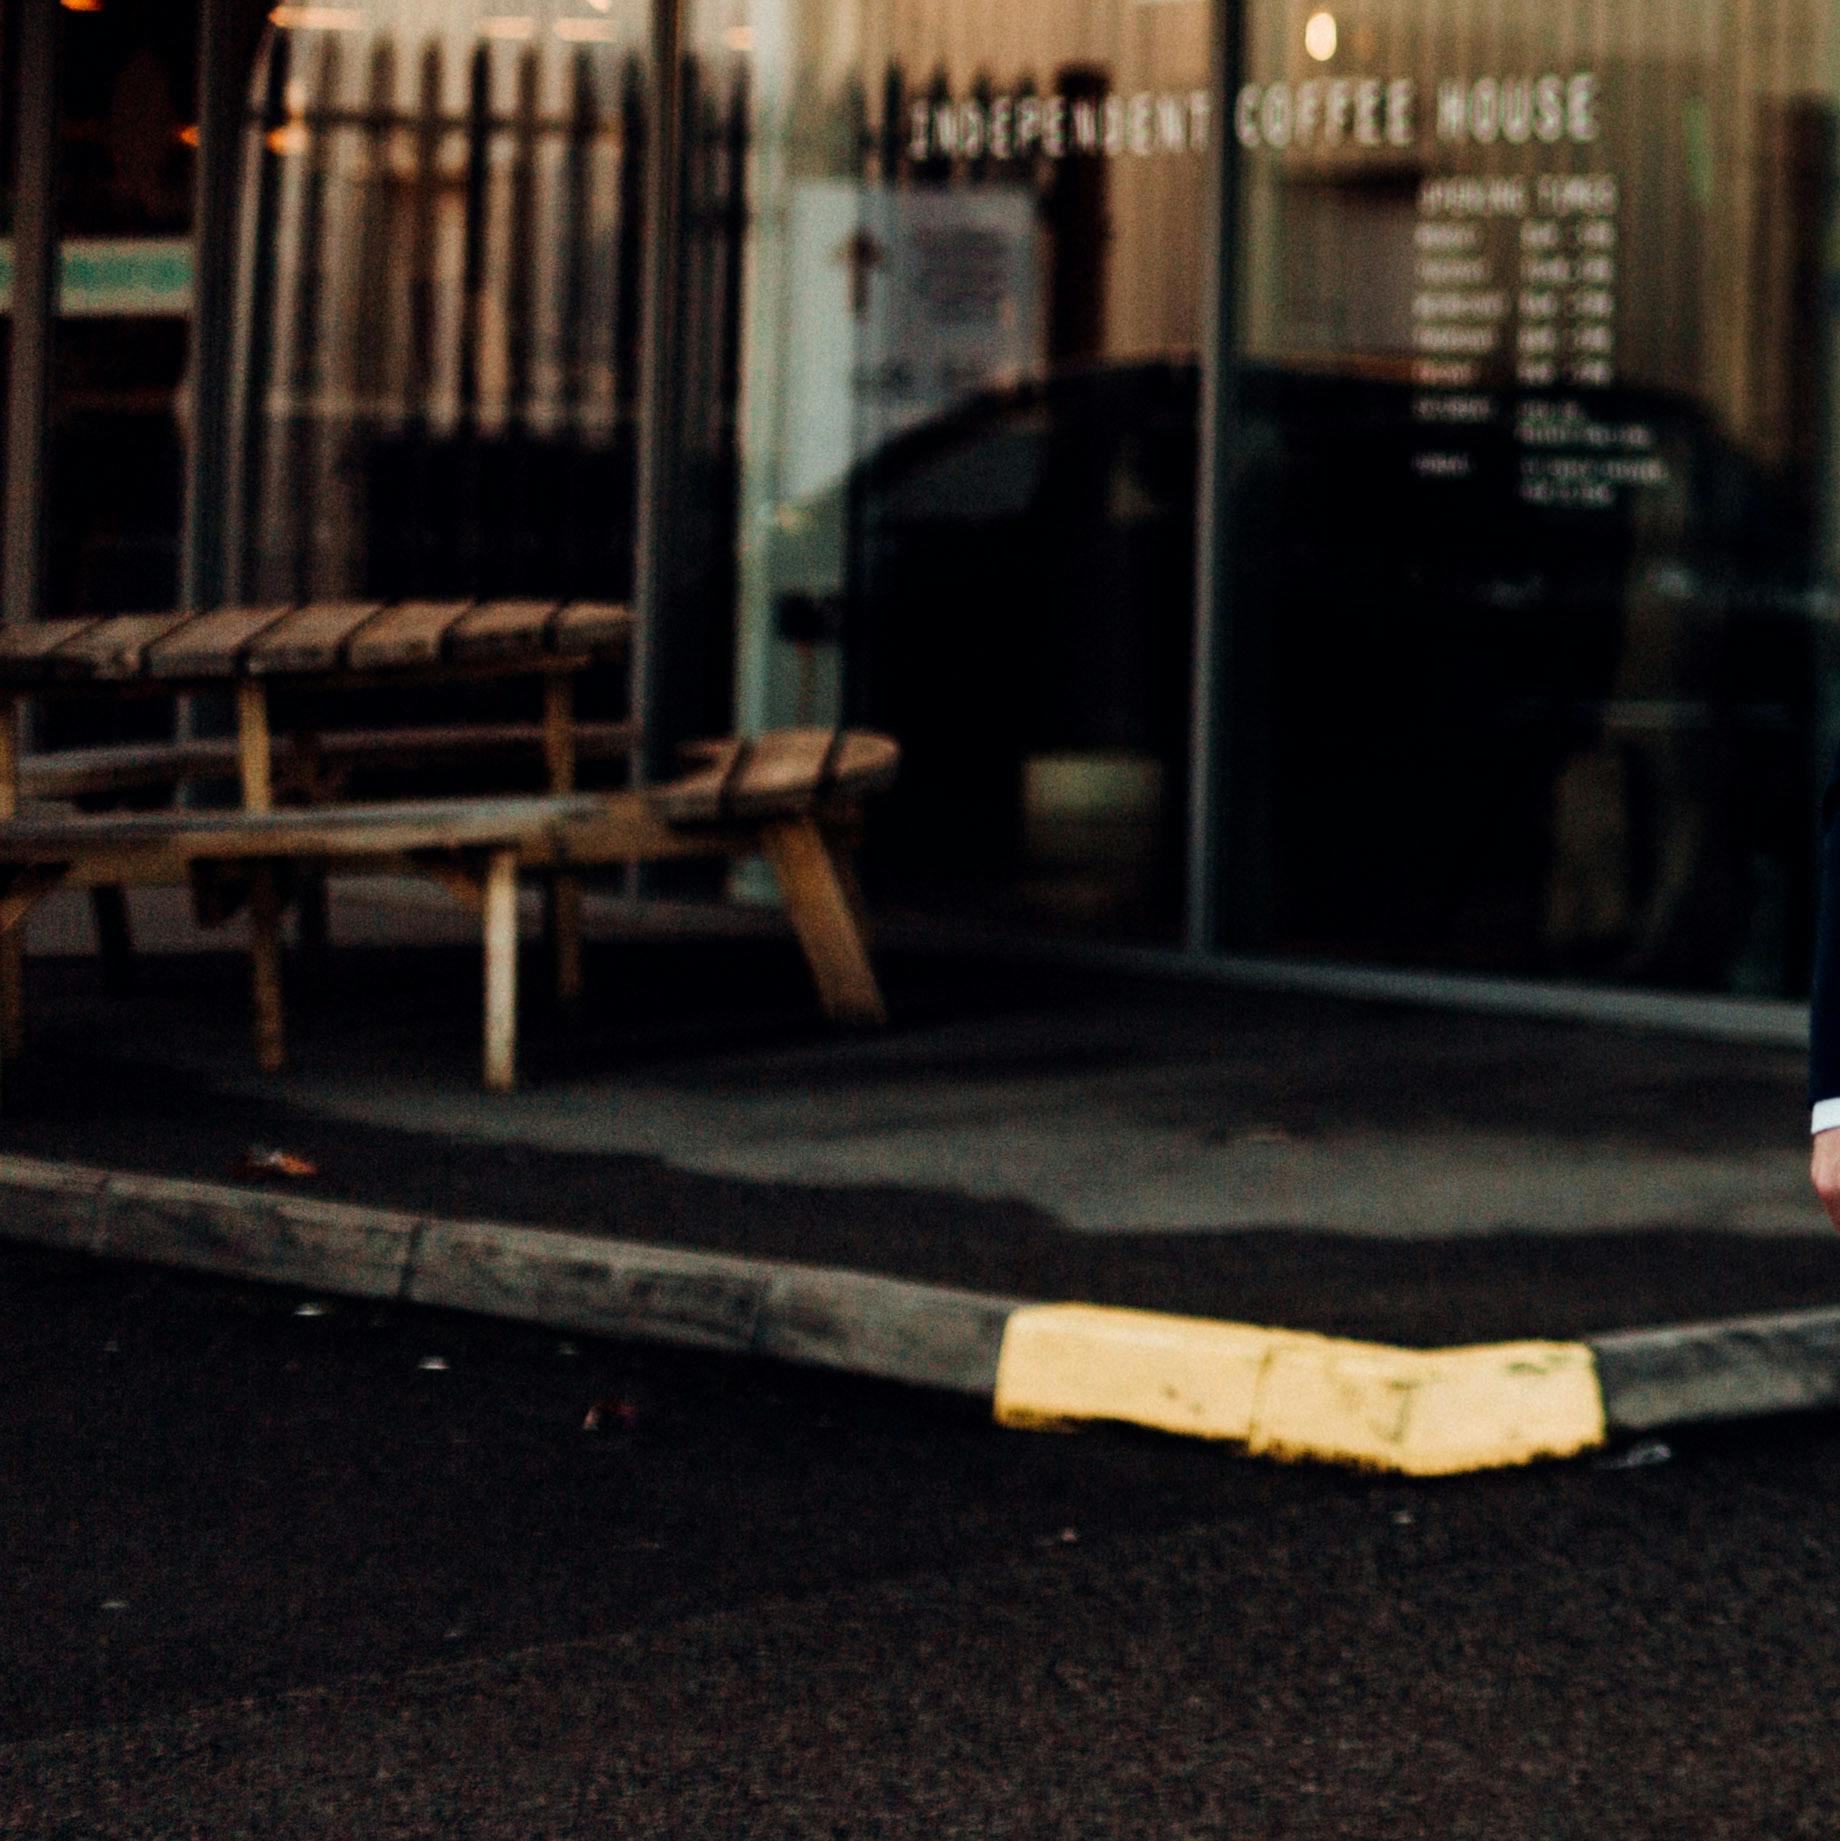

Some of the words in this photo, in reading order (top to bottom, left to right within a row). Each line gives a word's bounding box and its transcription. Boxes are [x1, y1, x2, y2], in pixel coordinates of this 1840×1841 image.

[908, 92, 1210, 160] INDEPENDENT
[1236, 79, 1412, 147] COFFEE
[1438, 72, 1597, 145] HOUSE
